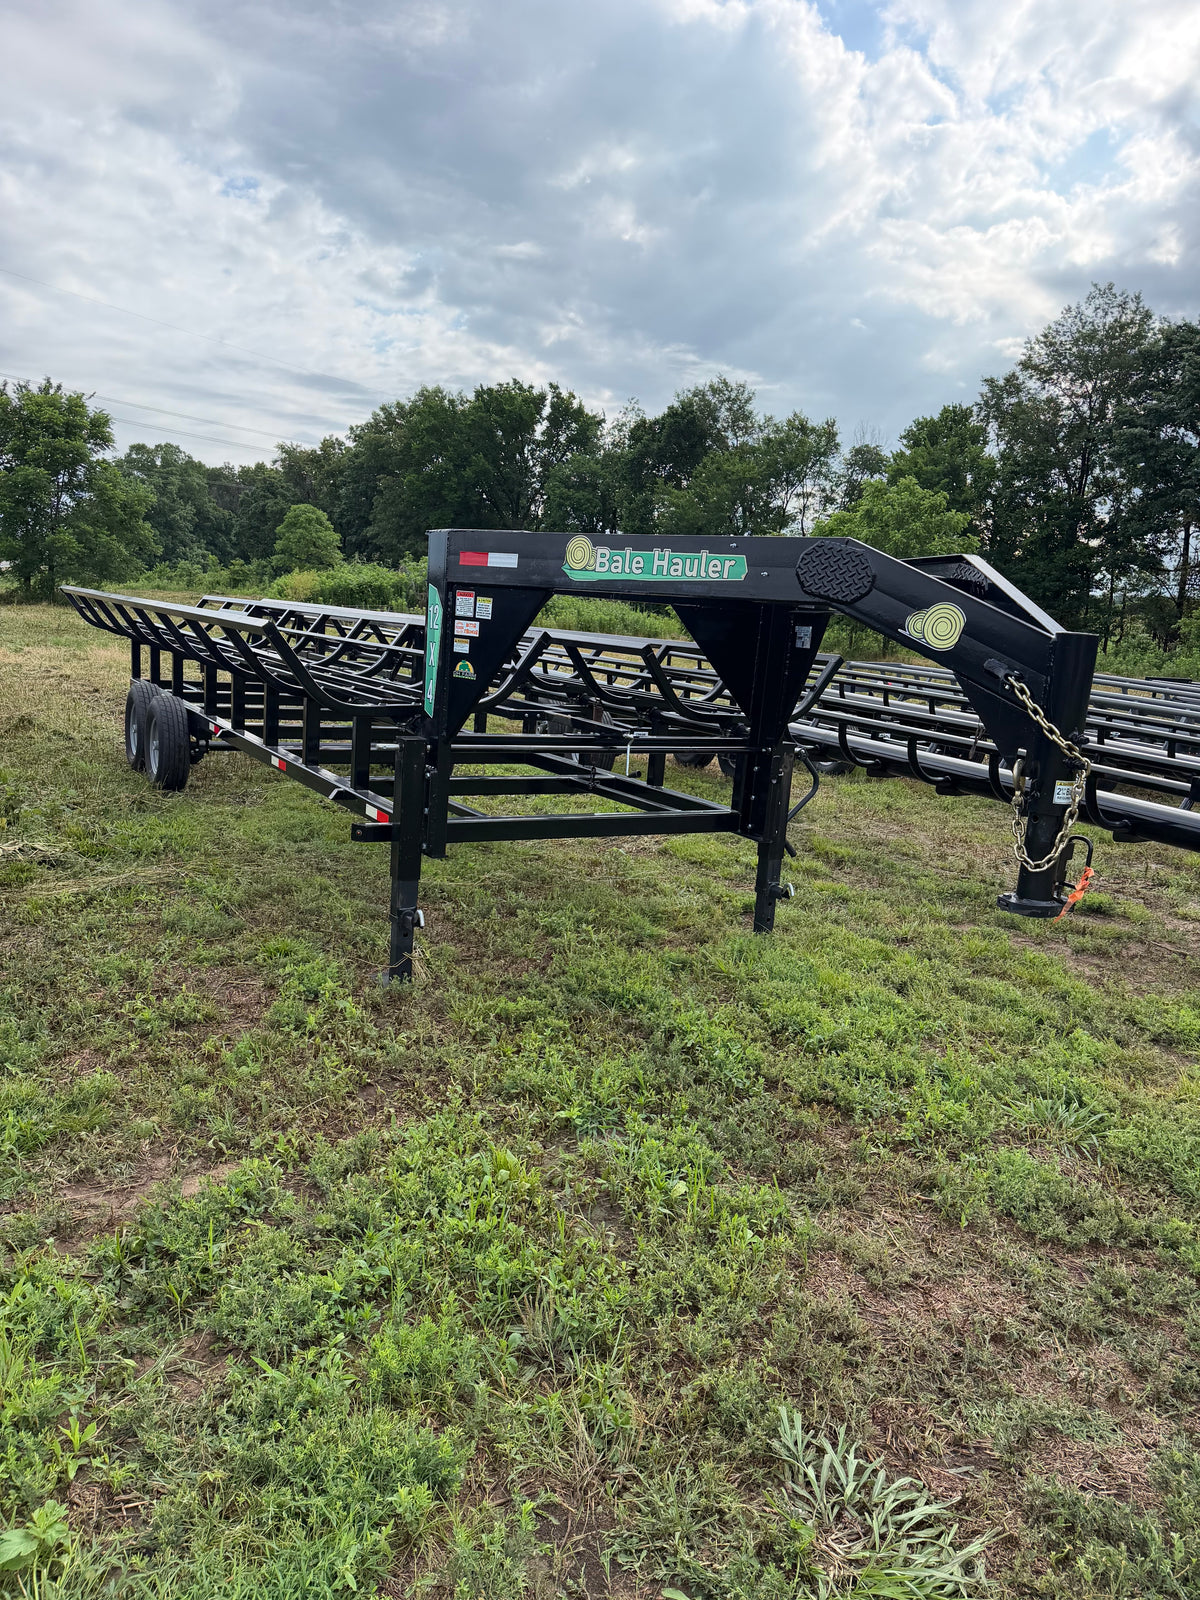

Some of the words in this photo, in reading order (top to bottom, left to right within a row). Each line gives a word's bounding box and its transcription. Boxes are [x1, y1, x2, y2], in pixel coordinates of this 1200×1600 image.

[594, 548, 645, 574] Bale
[652, 549, 737, 579] Hauler
[428, 604, 440, 630] 12
[428, 642, 436, 667] X
[426, 679, 434, 703] 4
